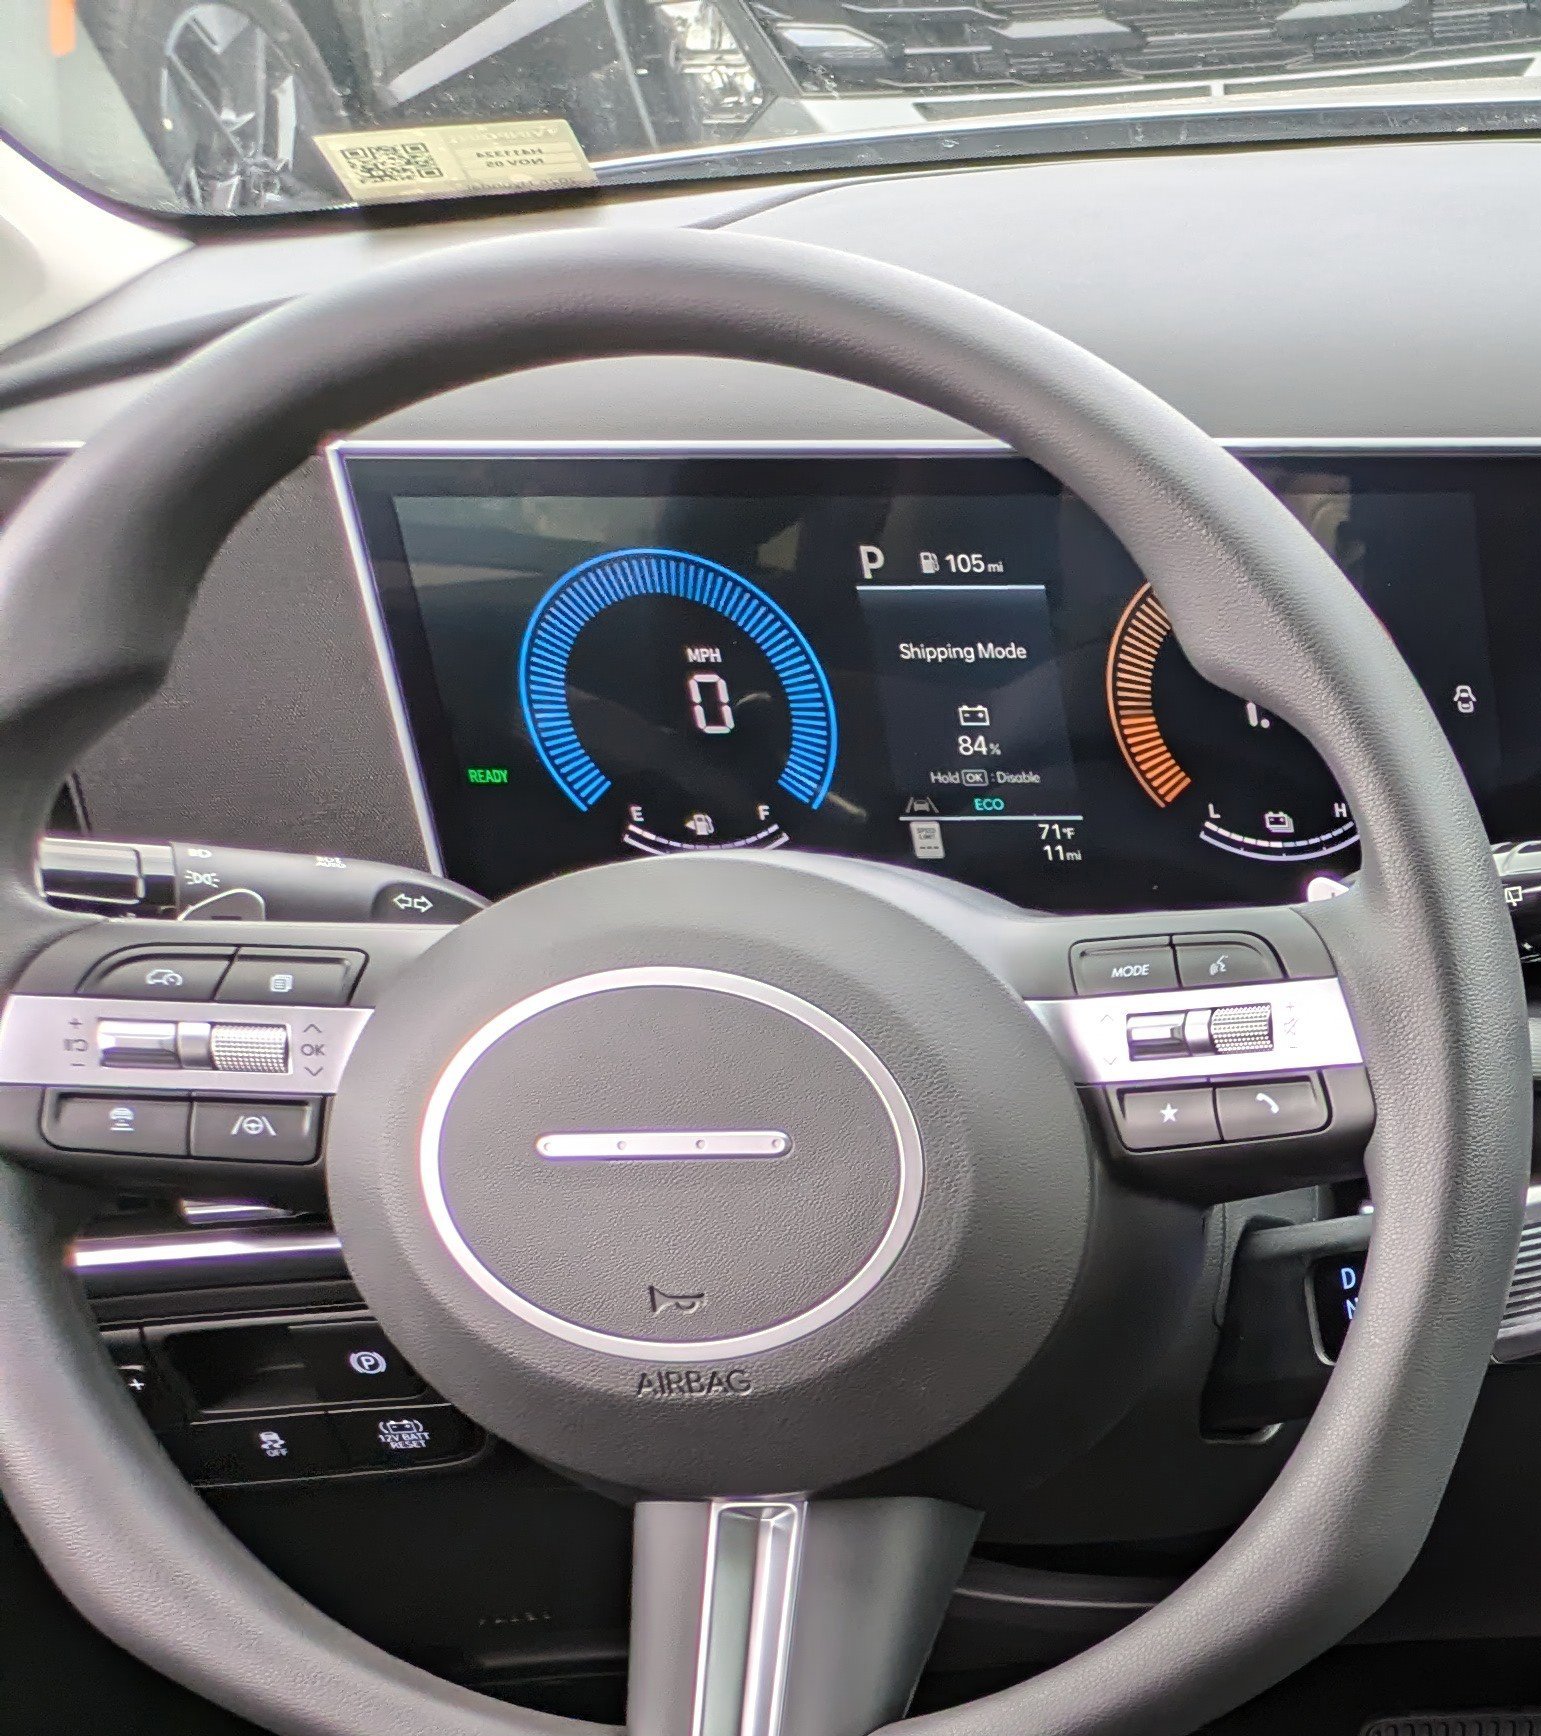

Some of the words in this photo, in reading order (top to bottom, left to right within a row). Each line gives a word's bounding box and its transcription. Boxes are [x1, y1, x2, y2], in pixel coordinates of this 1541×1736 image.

[859, 545, 885, 579] P
[945, 554, 985, 573] 105
[987, 561, 1004, 573] mi
[687, 648, 722, 664] MPH
[899, 643, 974, 663] Shipping
[977, 643, 1027, 659] Mode
[688, 673, 735, 735] 0
[469, 768, 508, 784] READY
[930, 771, 960, 784] Hold
[966, 773, 983, 782] OK
[997, 771, 1041, 784] Disable
[758, 805, 771, 820] F
[974, 798, 1004, 811] ECO
[1208, 803, 1221, 819] L
[1334, 803, 1347, 818] H
[630, 806, 645, 822] E
[1111, 963, 1151, 979] MODE
[300, 1043, 325, 1057] OK
[1341, 1267, 1356, 1290] D
[636, 1369, 752, 1398] AIRBAG
[378, 1433, 401, 1443] 12V
[401, 1431, 430, 1441] BATT
[389, 1440, 427, 1449] RESET
[266, 1448, 288, 1457] OFF
